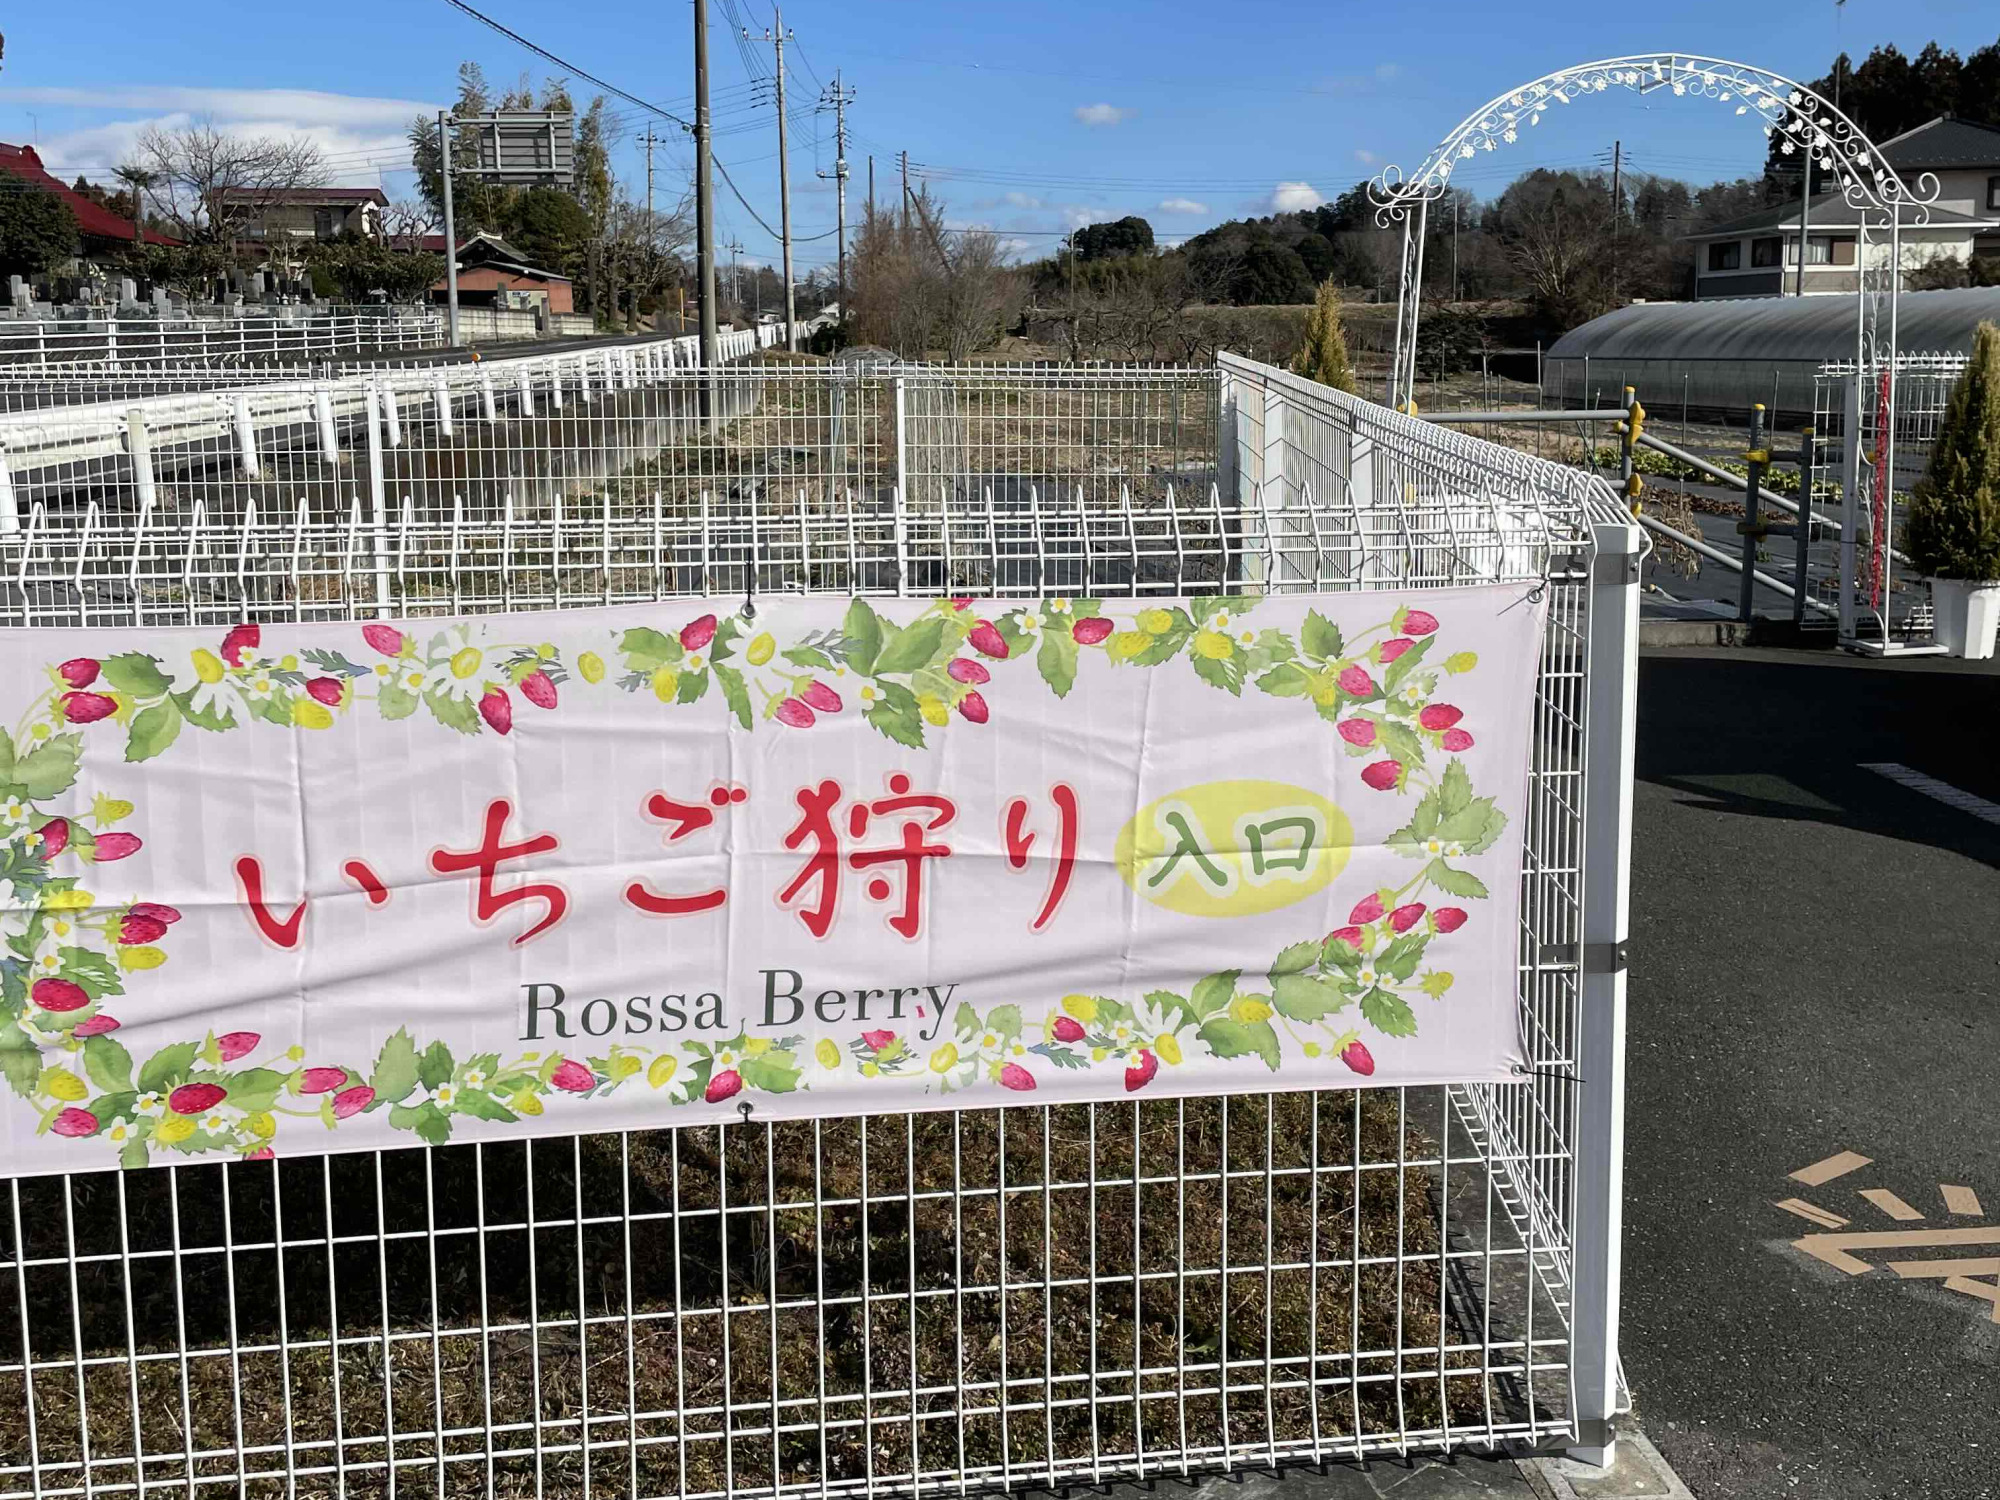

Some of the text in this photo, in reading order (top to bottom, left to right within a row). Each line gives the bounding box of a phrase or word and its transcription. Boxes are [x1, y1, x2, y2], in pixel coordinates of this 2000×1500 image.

[235, 773, 1316, 948] いちご狩り 入口
[518, 969, 960, 1041] Rossa Berry
